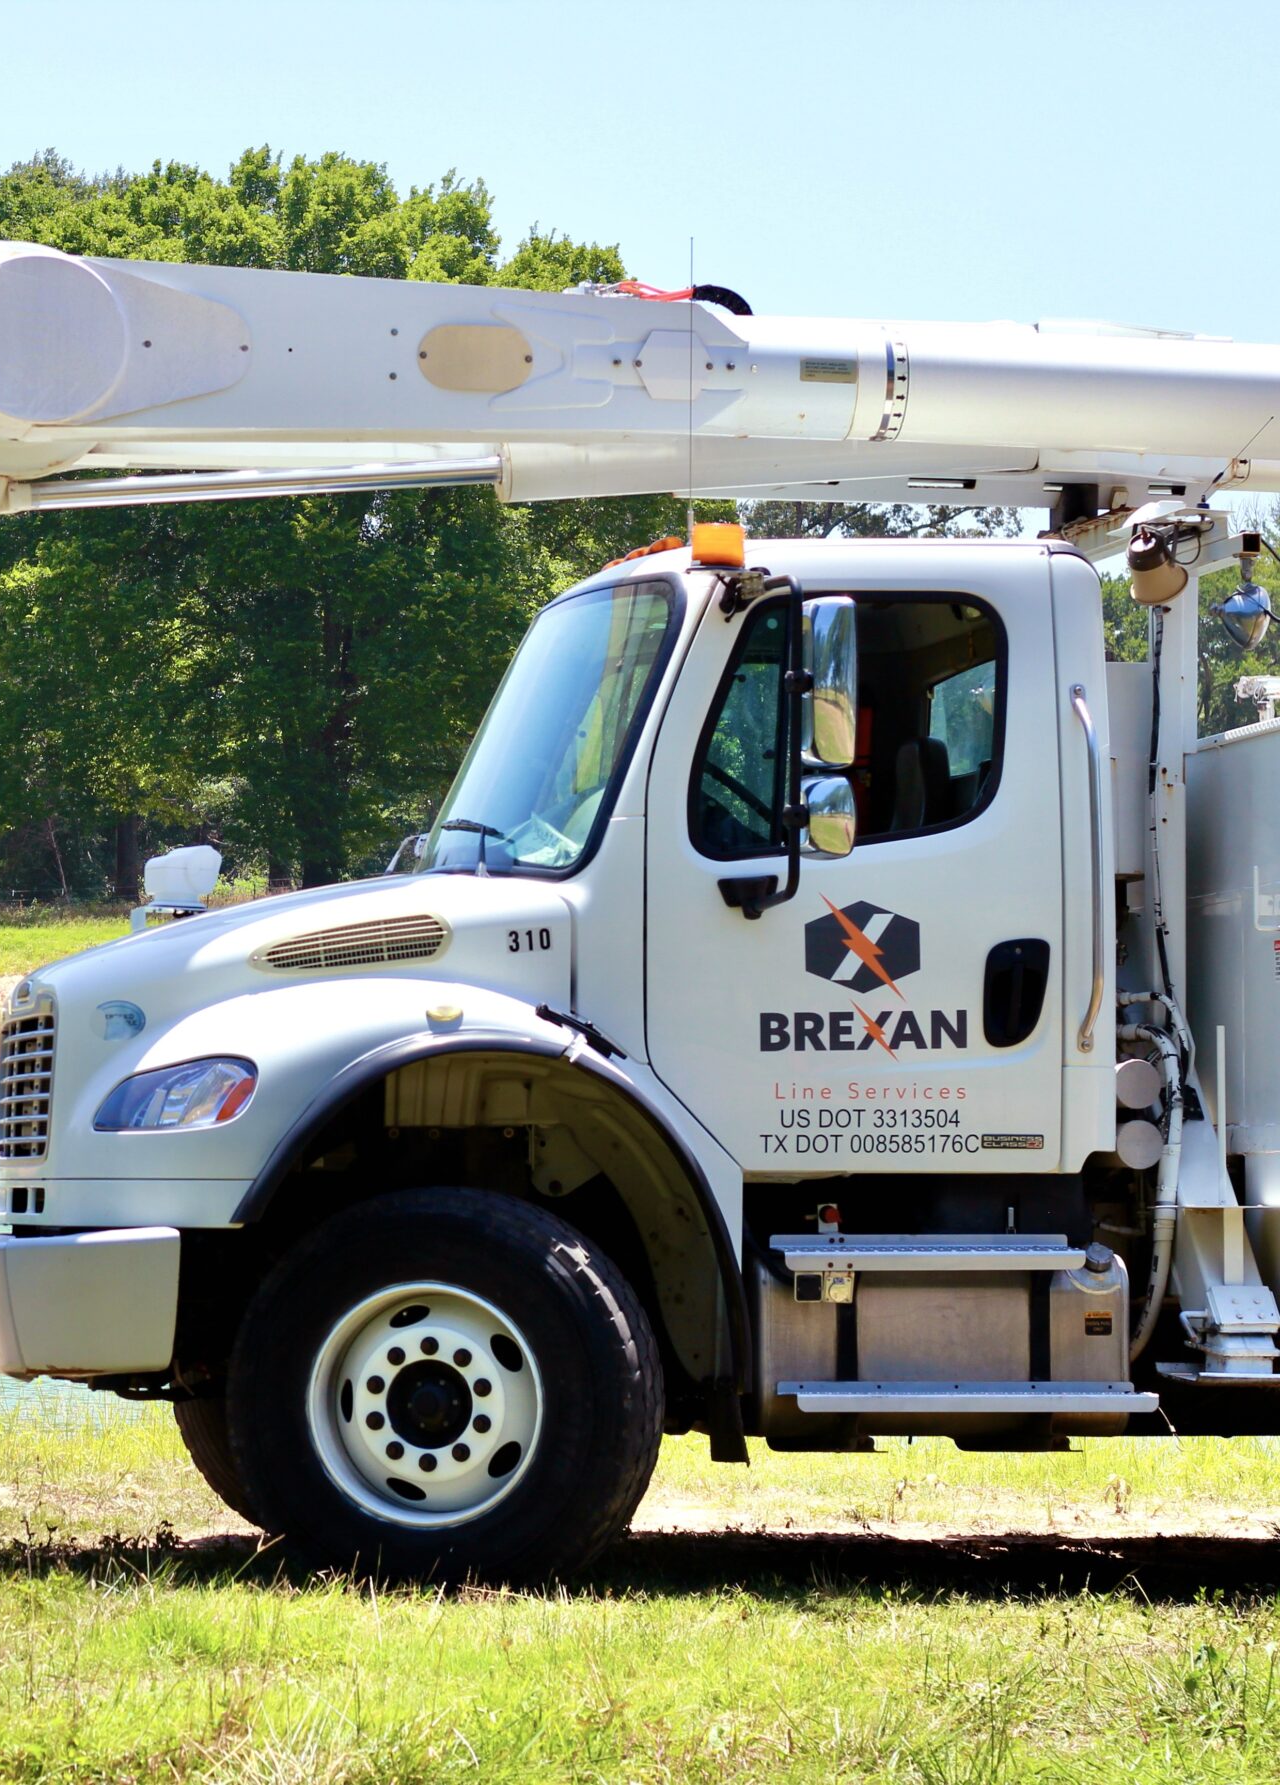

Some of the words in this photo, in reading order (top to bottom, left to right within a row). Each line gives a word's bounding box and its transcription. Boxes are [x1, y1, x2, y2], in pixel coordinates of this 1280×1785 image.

[508, 928, 551, 952] 310
[760, 1008, 968, 1053] BREXAN
[775, 1083, 832, 1100] Line
[848, 1082, 967, 1100] Services
[780, 1109, 811, 1128] US
[818, 1109, 866, 1128] DOT
[873, 1109, 960, 1128] 3313504
[760, 1134, 788, 1153] TX
[795, 1134, 843, 1154] DOT
[850, 1134, 979, 1153] 008585176C
